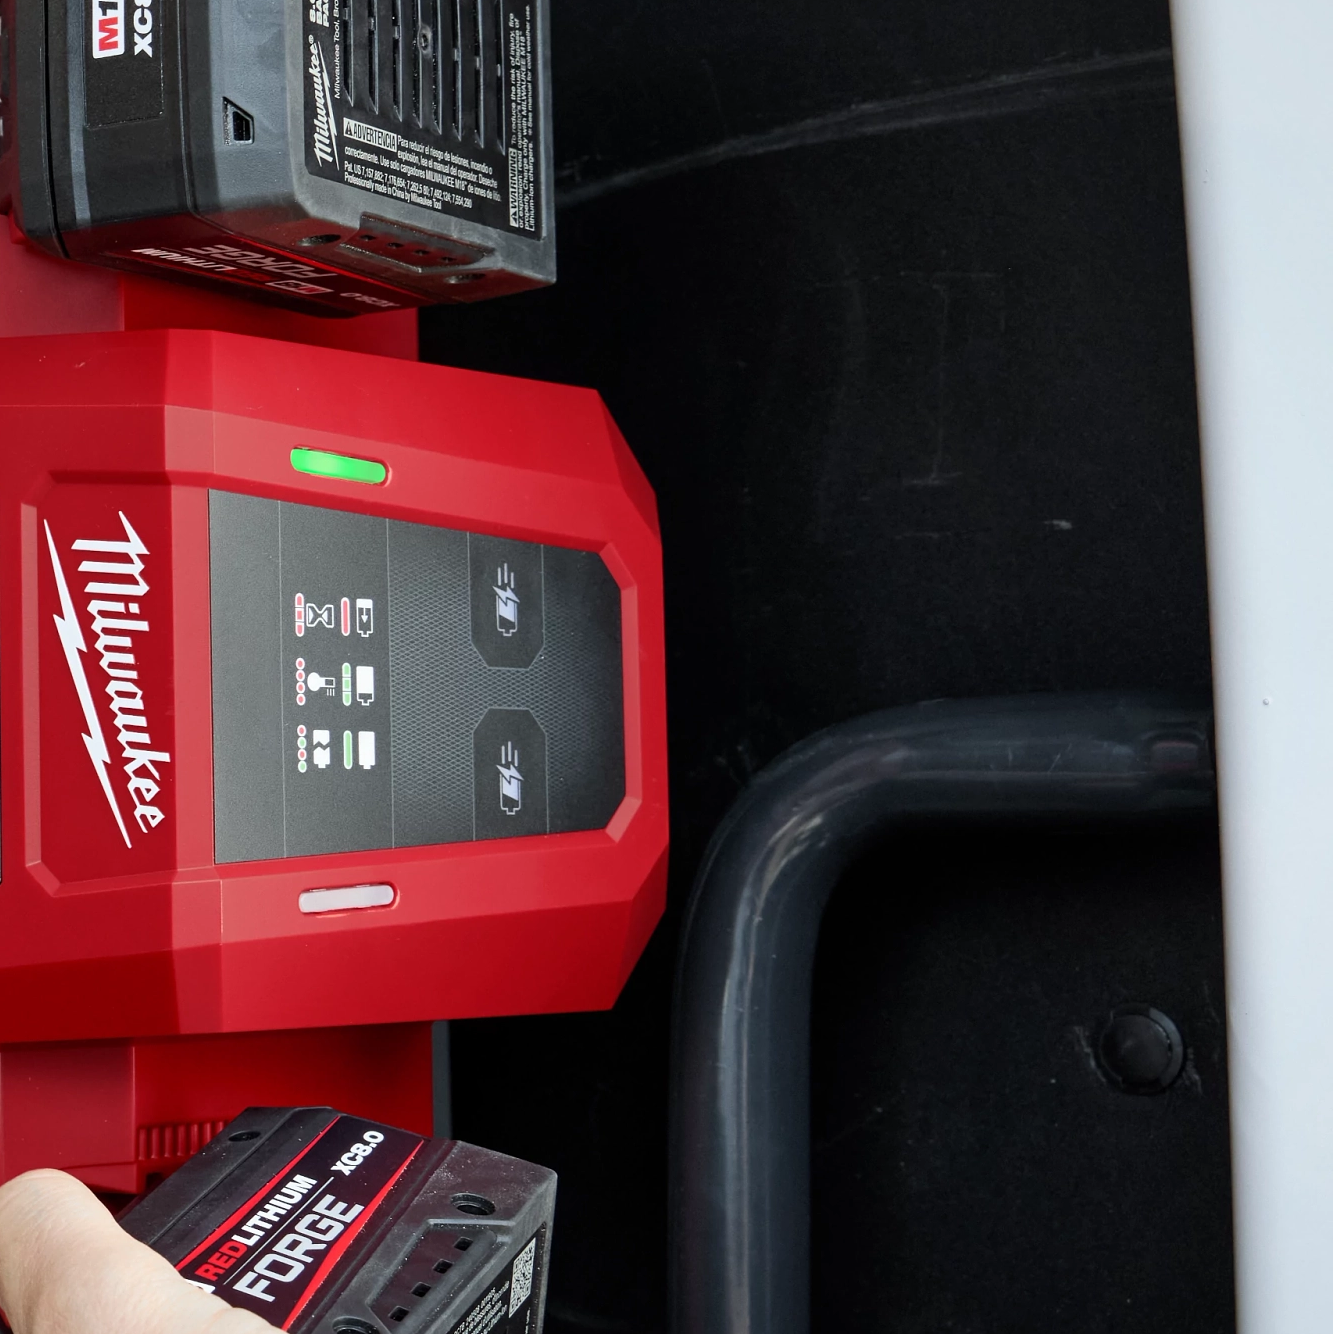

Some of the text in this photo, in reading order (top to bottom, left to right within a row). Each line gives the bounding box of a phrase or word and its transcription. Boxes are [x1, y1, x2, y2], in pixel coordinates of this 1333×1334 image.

[354, 124, 395, 149] ADVERTENCIA
[183, 244, 338, 278] FORGE
[71, 510, 171, 834] Milwaukee
[330, 1130, 385, 1176] XC8.0
[194, 1173, 318, 1282] REDLITHIUM
[233, 1193, 365, 1303] FORGE
